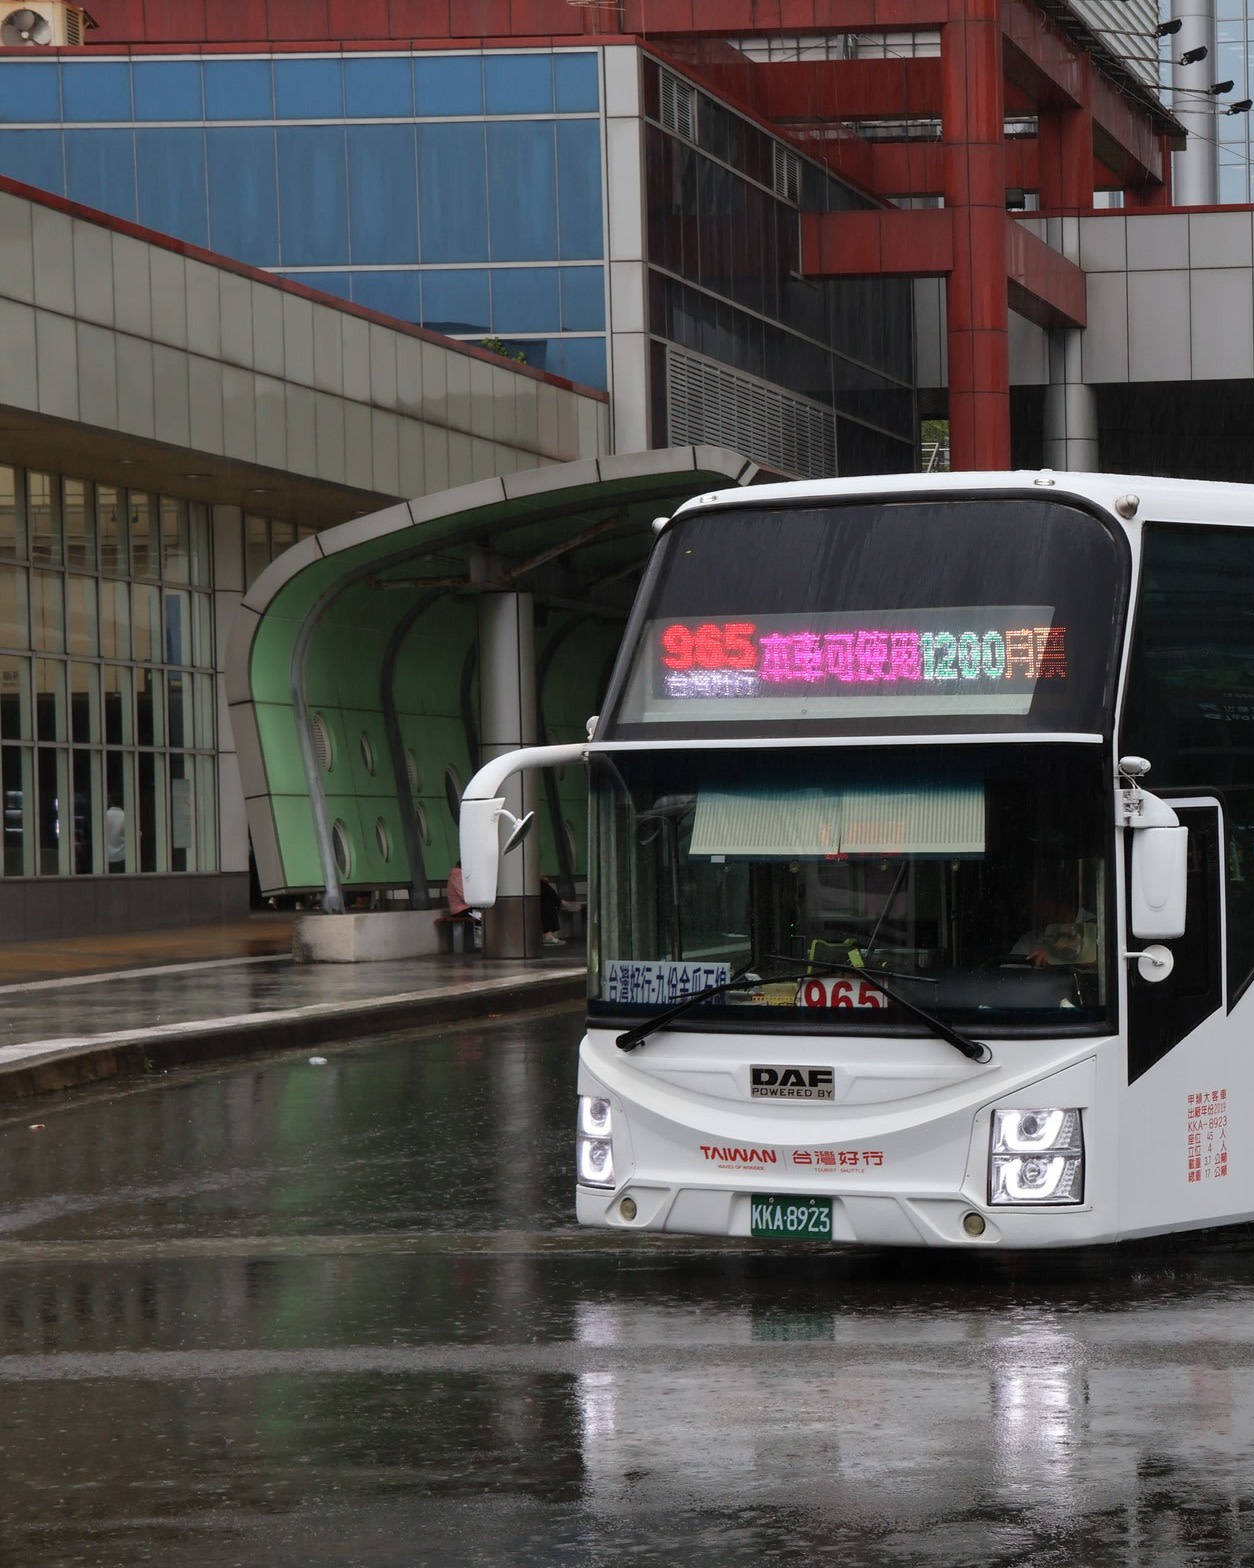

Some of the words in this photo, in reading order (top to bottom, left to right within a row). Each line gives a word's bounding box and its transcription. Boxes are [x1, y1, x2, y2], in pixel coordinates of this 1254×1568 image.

[661, 622, 756, 670] 965
[804, 979, 881, 1008] 965
[752, 1068, 833, 1087] DAF
[752, 1087, 812, 1097] POWERED
[818, 1089, 832, 1098] BY
[1188, 1115, 1228, 1132] KKA-8923
[700, 1146, 777, 1164] TAIWAN
[792, 1151, 884, 1166] 台灣好行
